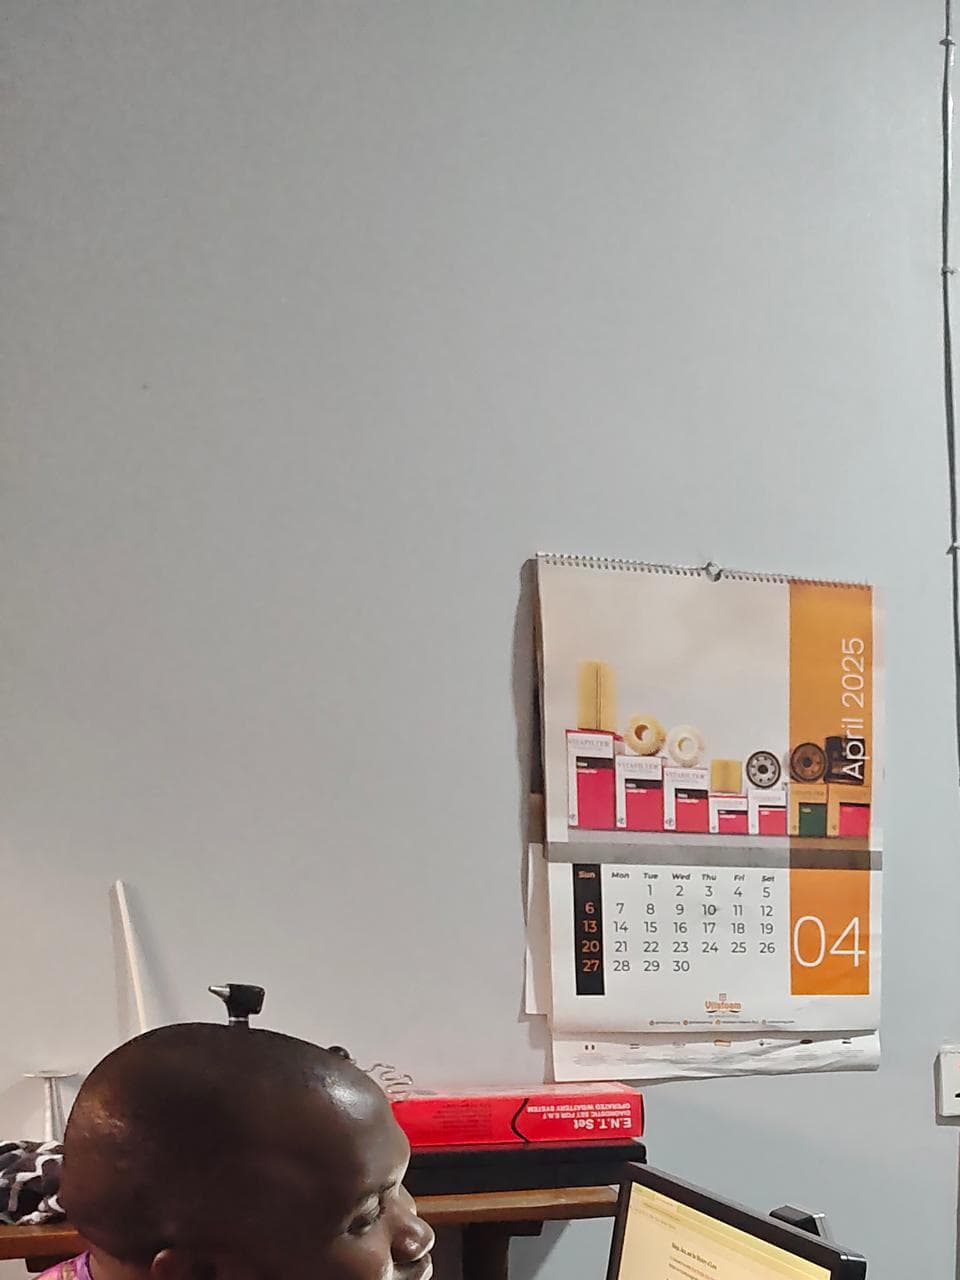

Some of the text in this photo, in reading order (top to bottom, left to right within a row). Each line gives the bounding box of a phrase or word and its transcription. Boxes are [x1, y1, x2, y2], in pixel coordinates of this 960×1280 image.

[842, 638, 870, 779] April 2025
[577, 871, 596, 879] Sun
[647, 884, 771, 898] 1 2 3 4 5
[585, 902, 773, 917] 6 7 8 9 10 11 12
[582, 920, 774, 935] 13 14 15 16 17 18 19
[581, 940, 776, 954] 20 21 22 23 24 25 26
[793, 915, 866, 968] 04
[582, 960, 690, 972] 27 28 29 30
[573, 1117, 632, 1130] E.N.T. Set
